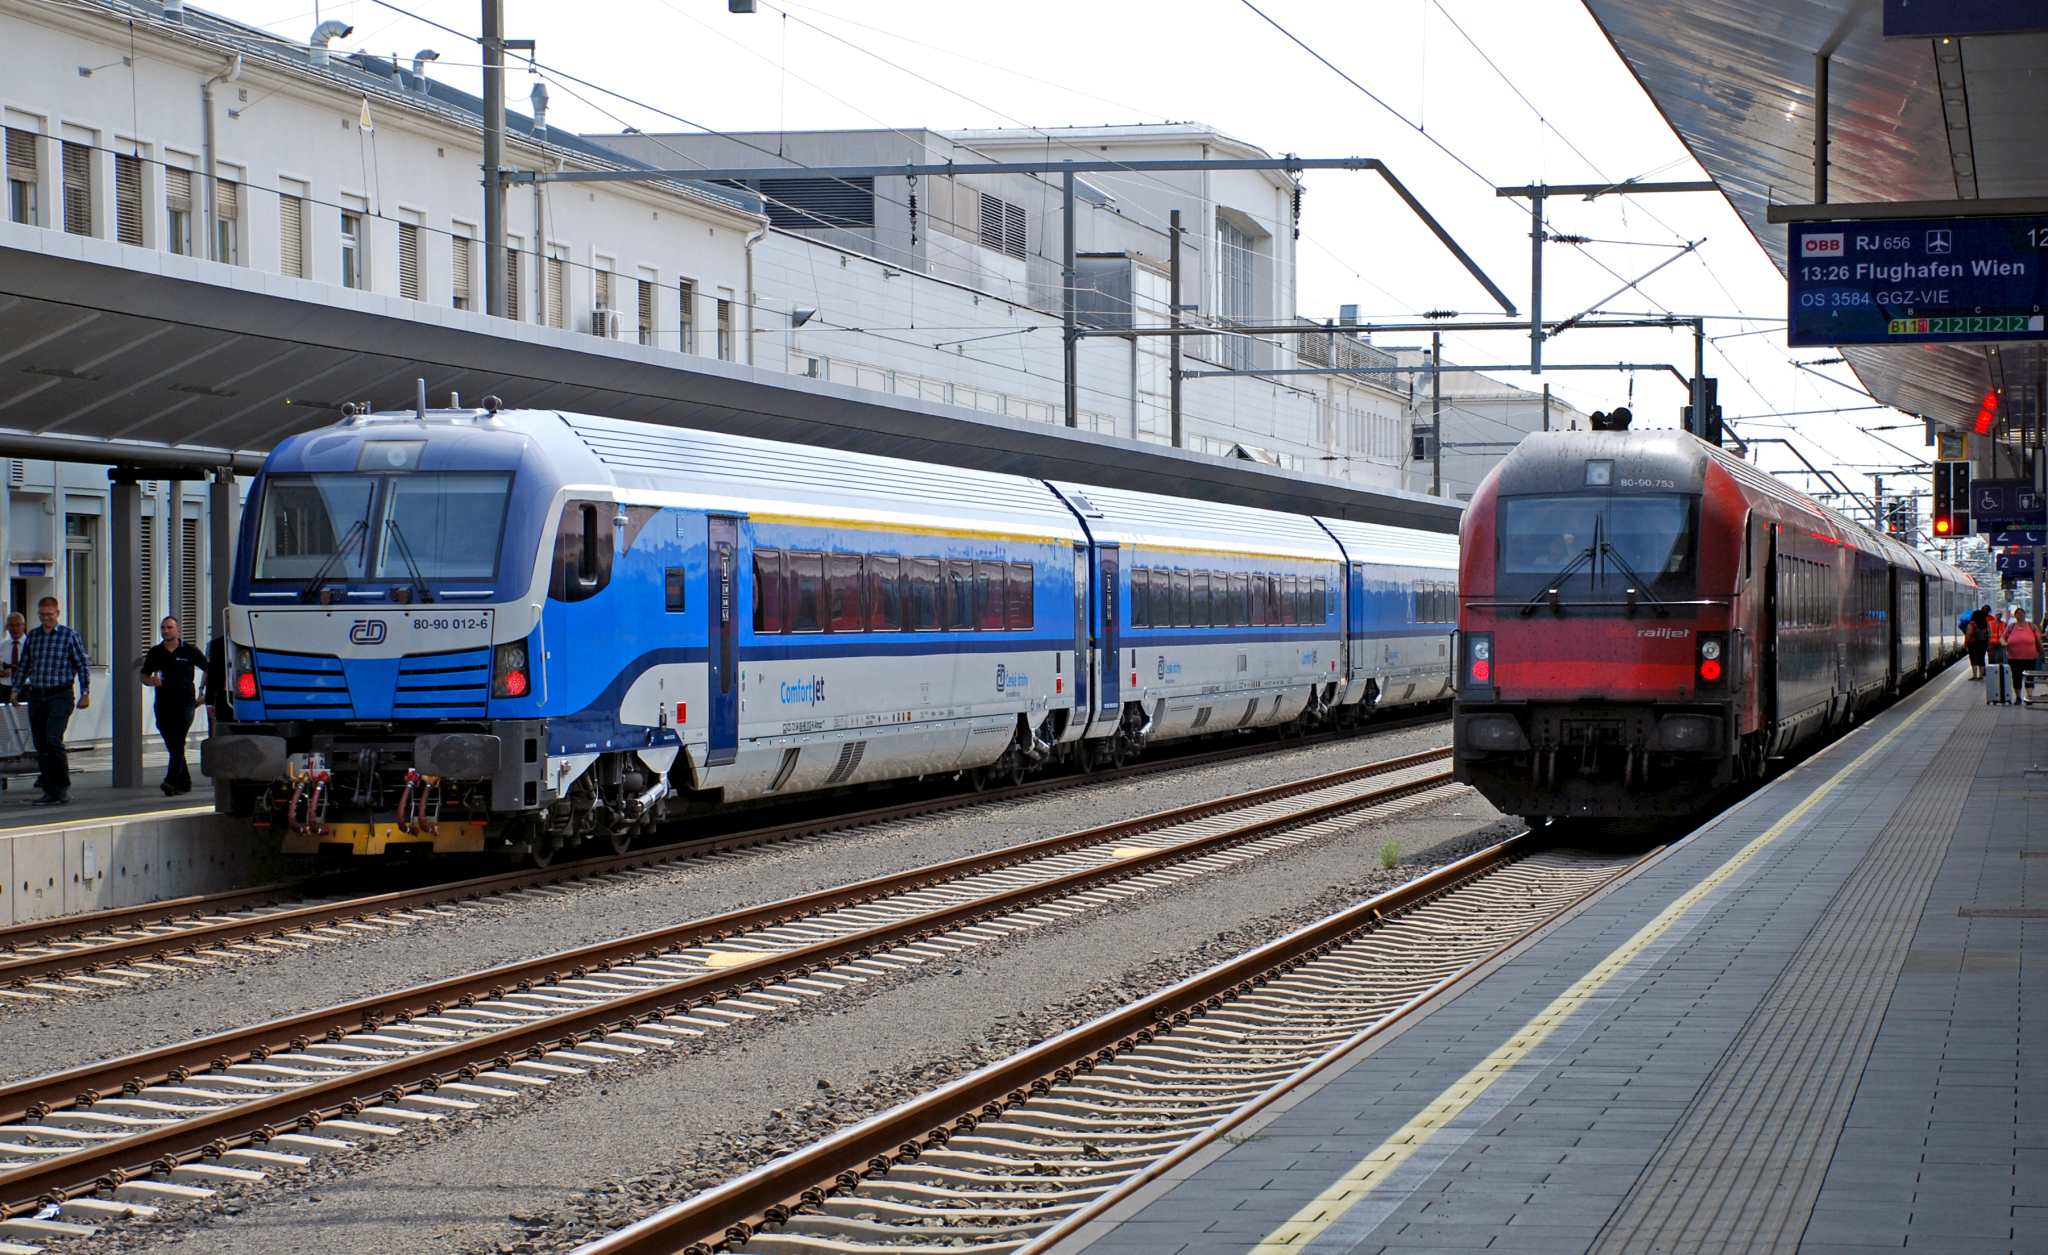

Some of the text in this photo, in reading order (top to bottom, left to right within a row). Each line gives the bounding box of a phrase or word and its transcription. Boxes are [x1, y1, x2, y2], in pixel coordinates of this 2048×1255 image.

[1856, 236, 1880, 251] RJ
[1883, 237, 1911, 250] 656
[2027, 228, 2048, 247] 12
[1801, 260, 2025, 283] 13:26 Flughafen Wien
[1801, 289, 1950, 307] OS 3584 GGZ-VIE
[1831, 305, 2040, 318] A B C D
[1933, 319, 1943, 332] 2
[1953, 319, 1963, 332] 2
[1973, 318, 1983, 332] 2
[1993, 318, 2003, 331] 2
[2013, 317, 2024, 331] 2
[1620, 478, 1675, 488] 80-90.753
[2001, 556, 2027, 569] 2 D
[413, 618, 488, 630] 80-90 012-6
[1637, 627, 1690, 640] railjet
[780, 674, 826, 708] ComfortJet
